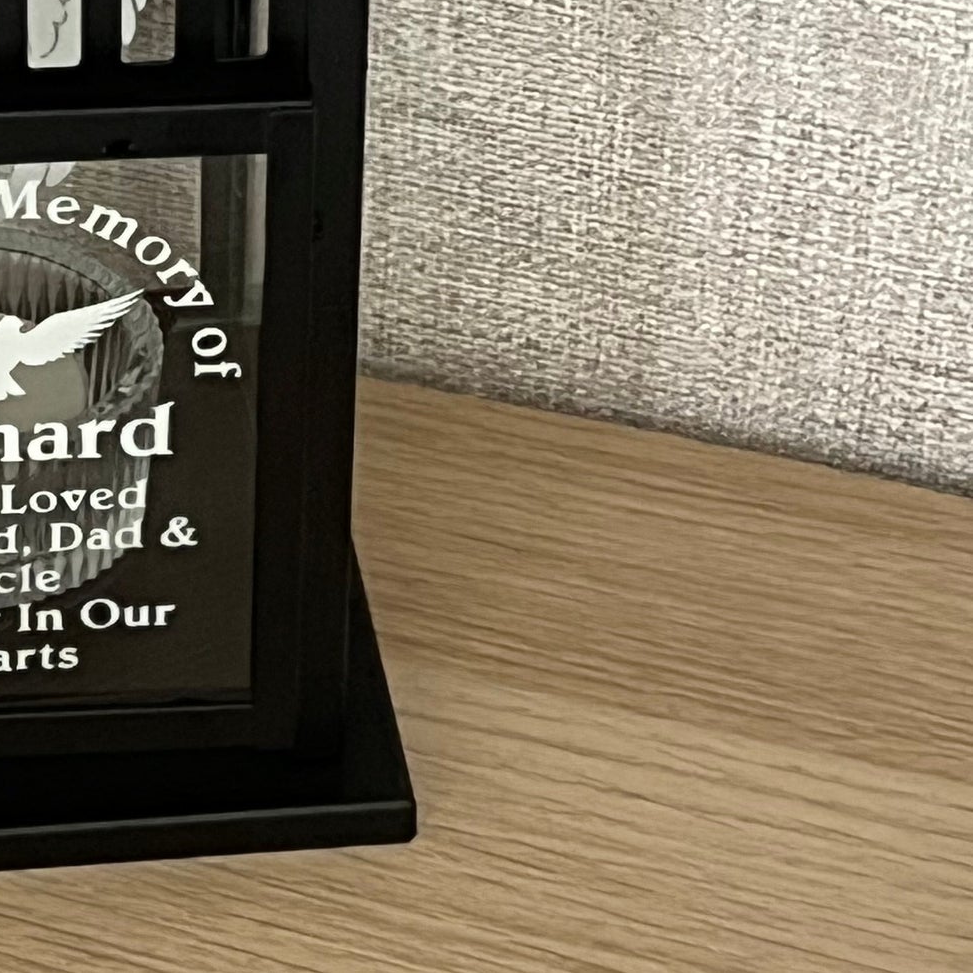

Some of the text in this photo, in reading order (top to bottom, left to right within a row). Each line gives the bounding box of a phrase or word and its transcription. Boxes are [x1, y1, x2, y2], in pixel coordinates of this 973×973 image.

[191, 327, 242, 379] of
[0, 478, 147, 515] Loved
[49, 519, 143, 553] Dad
[160, 516, 198, 548] &
[17, 603, 64, 633] In
[80, 598, 176, 629] Our
